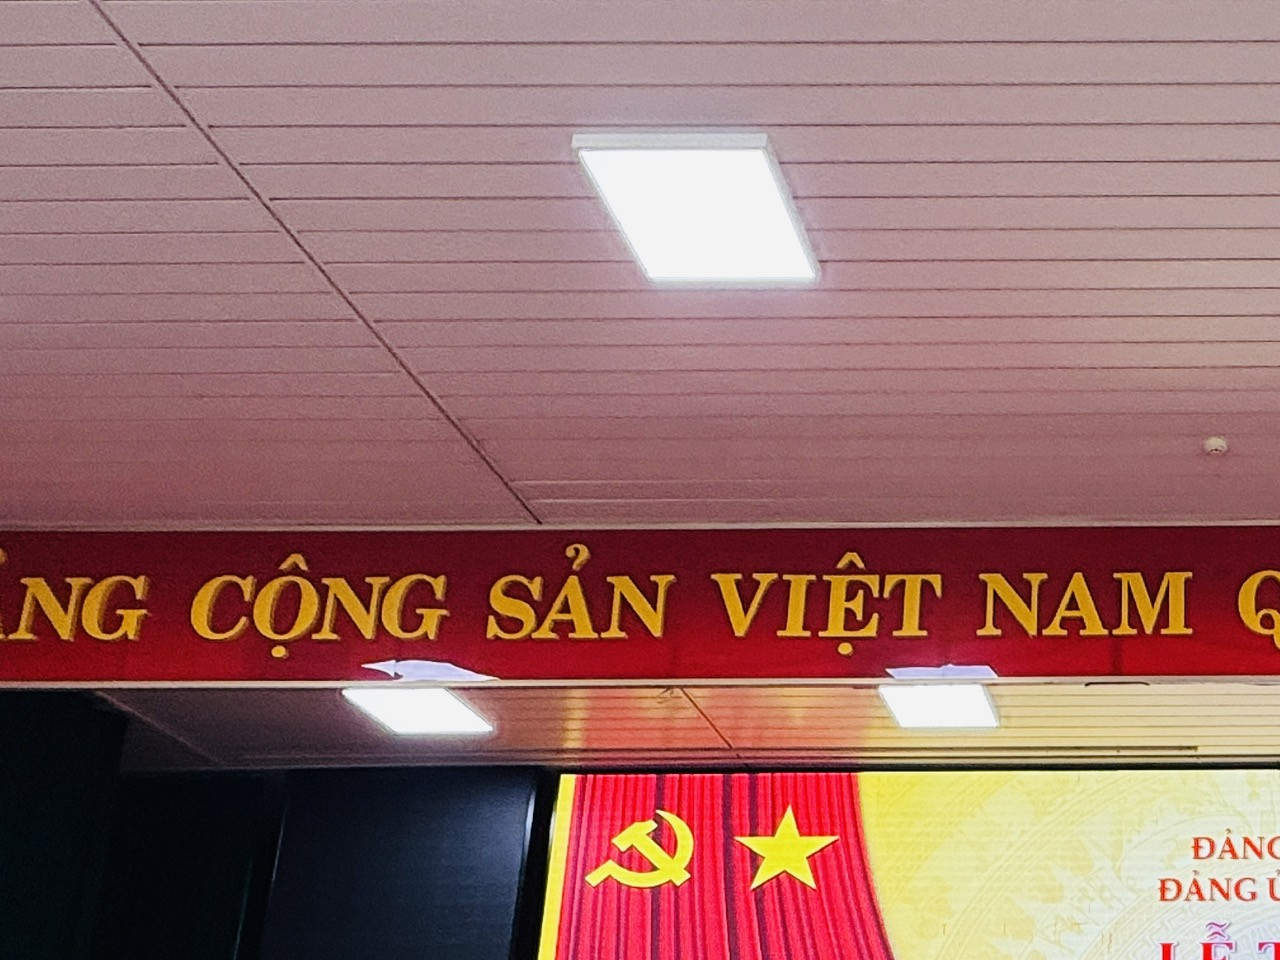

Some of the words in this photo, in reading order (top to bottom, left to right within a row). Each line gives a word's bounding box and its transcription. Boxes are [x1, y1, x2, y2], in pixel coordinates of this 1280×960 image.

[0, 549, 150, 641] NG
[191, 554, 447, 657] CỘNG
[487, 544, 674, 639] SẢN
[713, 553, 941, 655] VIỆT
[976, 571, 1194, 637] NAM
[1157, 870, 1258, 902] ĐẢNG
